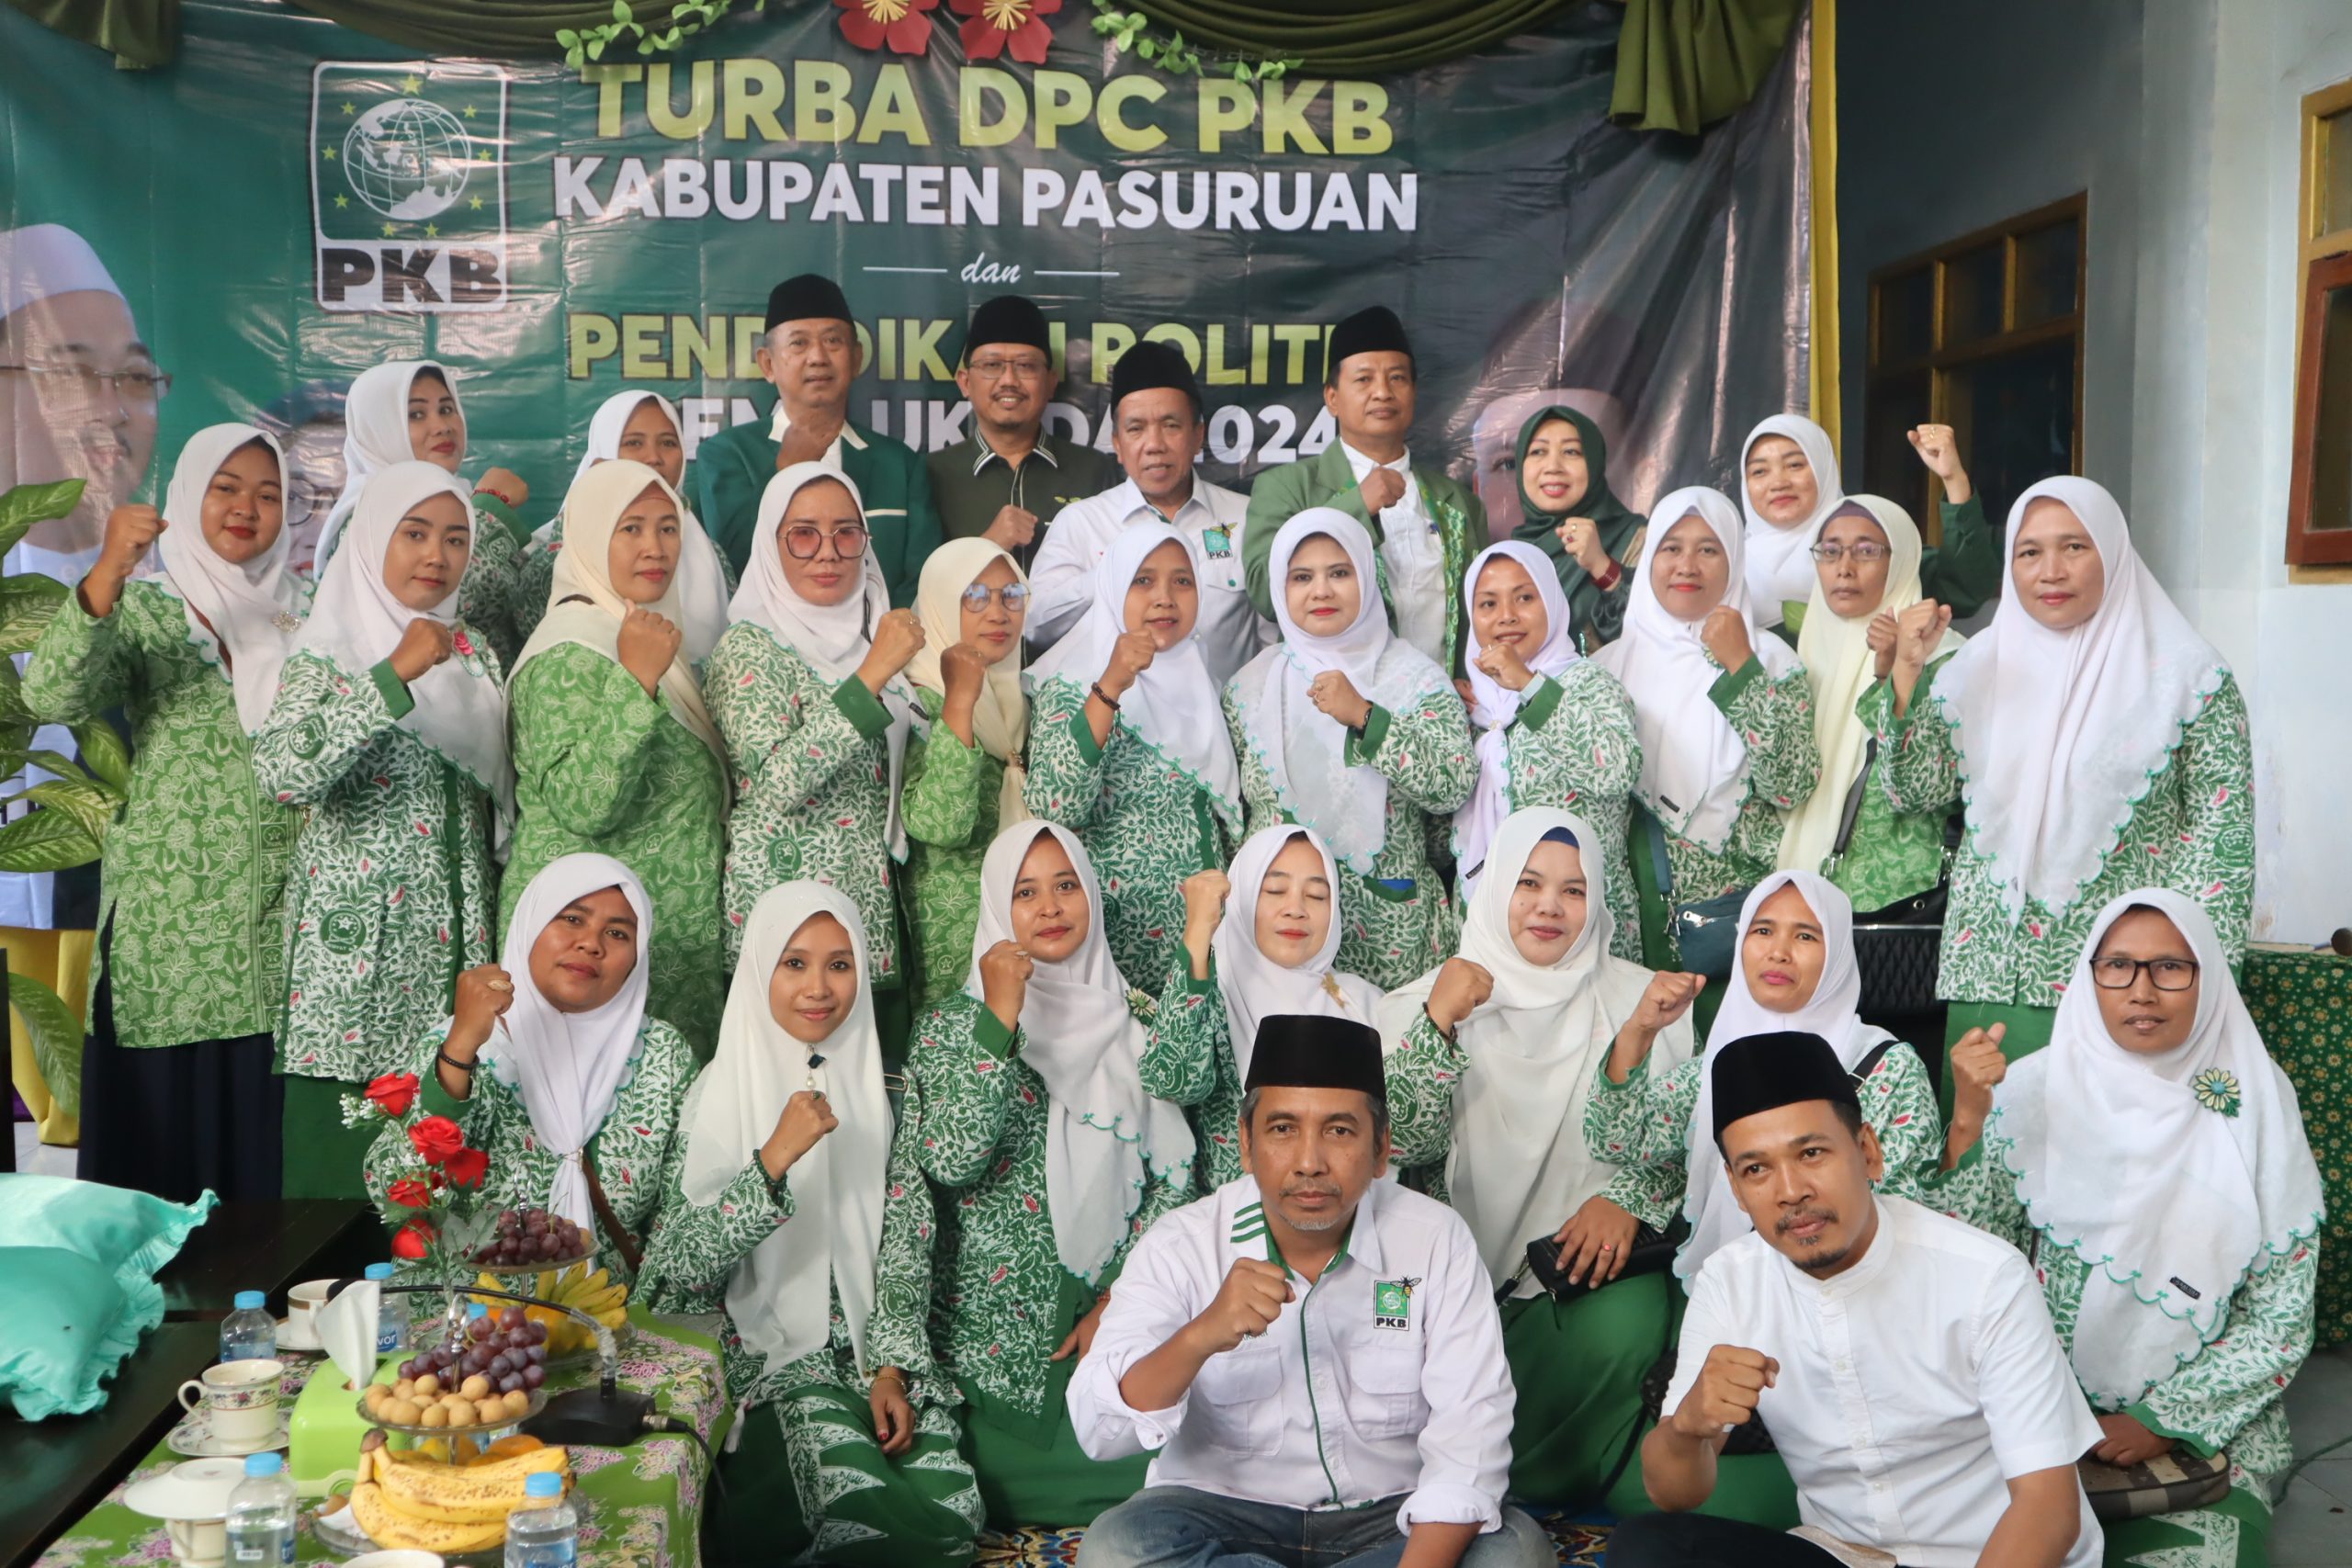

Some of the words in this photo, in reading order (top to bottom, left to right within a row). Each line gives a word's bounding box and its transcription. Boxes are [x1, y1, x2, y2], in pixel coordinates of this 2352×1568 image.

[581, 59, 931, 147] TURBA
[959, 65, 1169, 153] DPC
[1197, 78, 1395, 155] PKB
[553, 155, 999, 227] KABUPATEN
[1022, 168, 1418, 231] PASURUAN
[321, 246, 503, 305] PKB
[960, 252, 1021, 284] dan
[1193, 404, 1337, 463] 024
[1208, 551, 1231, 559] PKB
[1376, 1317, 1407, 1328] PKB
